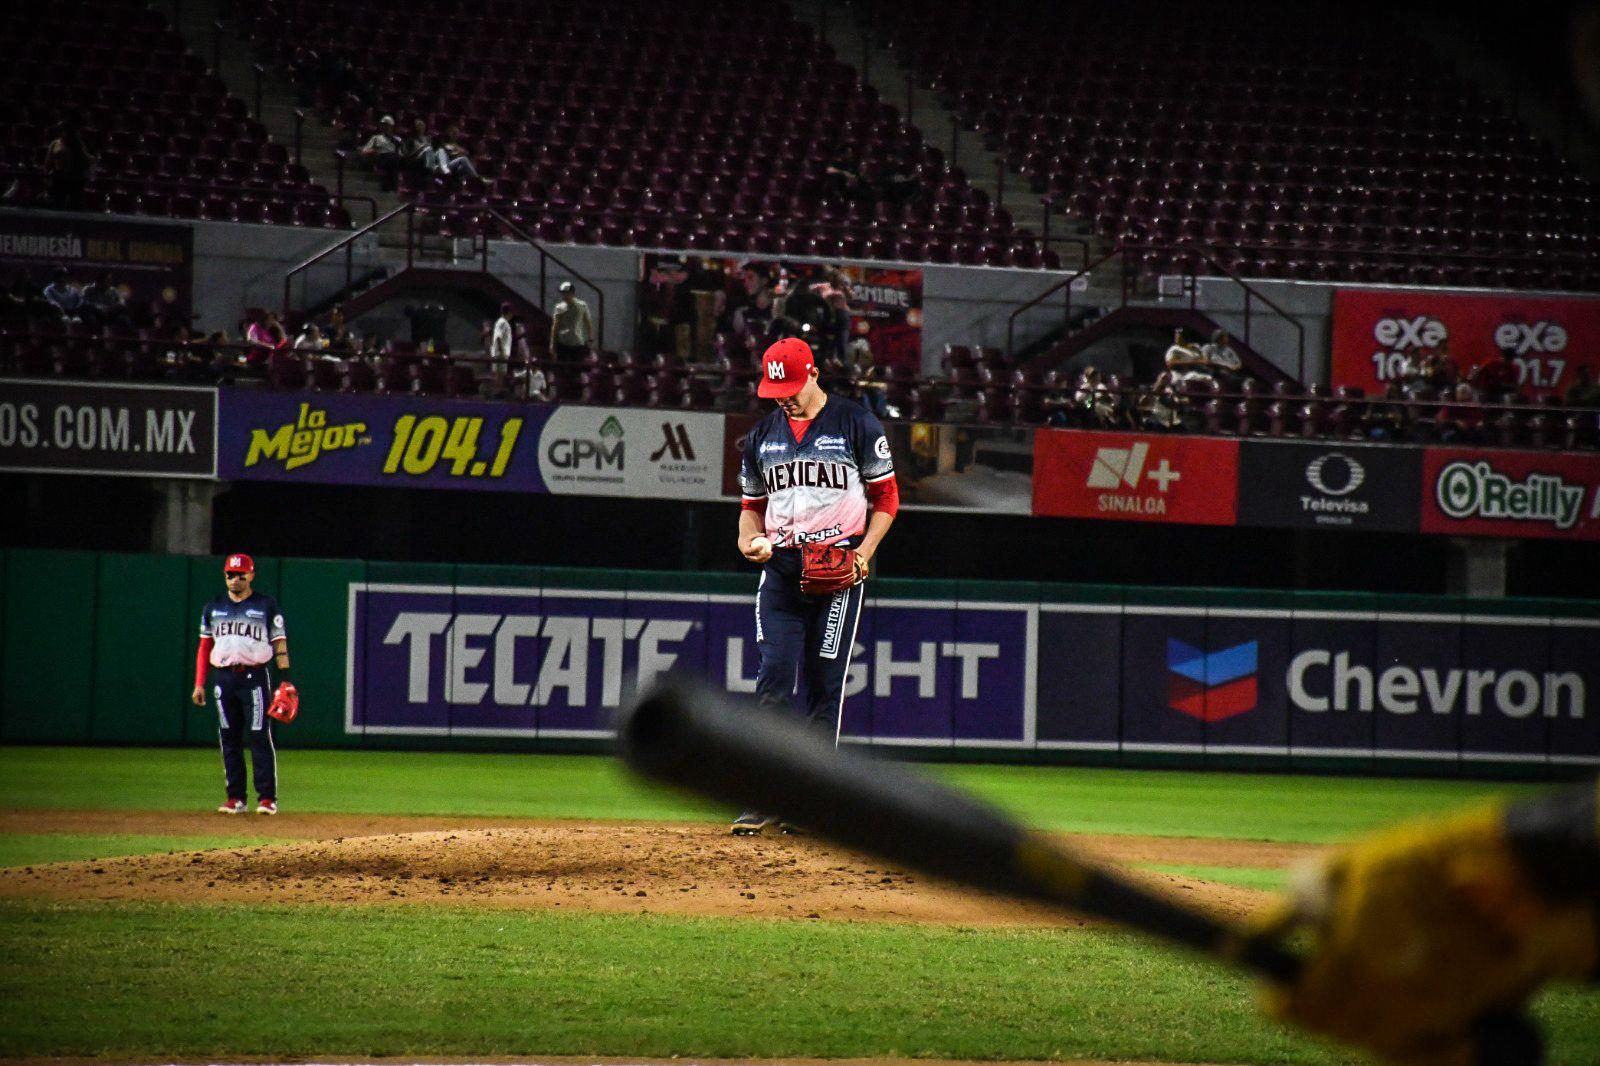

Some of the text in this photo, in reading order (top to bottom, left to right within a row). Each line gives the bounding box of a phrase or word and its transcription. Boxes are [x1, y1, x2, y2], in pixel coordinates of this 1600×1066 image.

[0, 233, 82, 258] EMBRESÍA
[1373, 316, 1448, 350] exa
[1494, 321, 1569, 354] exa
[300, 403, 326, 430] la
[245, 420, 366, 471] Mejor
[383, 415, 522, 477] 104.1
[548, 439, 625, 471] GPM
[763, 460, 848, 494] MEXICALI
[1098, 494, 1166, 514] SINALOA
[1299, 496, 1370, 514] Televisa
[1437, 462, 1586, 529] O'Reilly
[823, 587, 843, 649] PAQUETEXPRE
[383, 612, 694, 708] TECATE
[1286, 649, 1587, 719] Chevron
